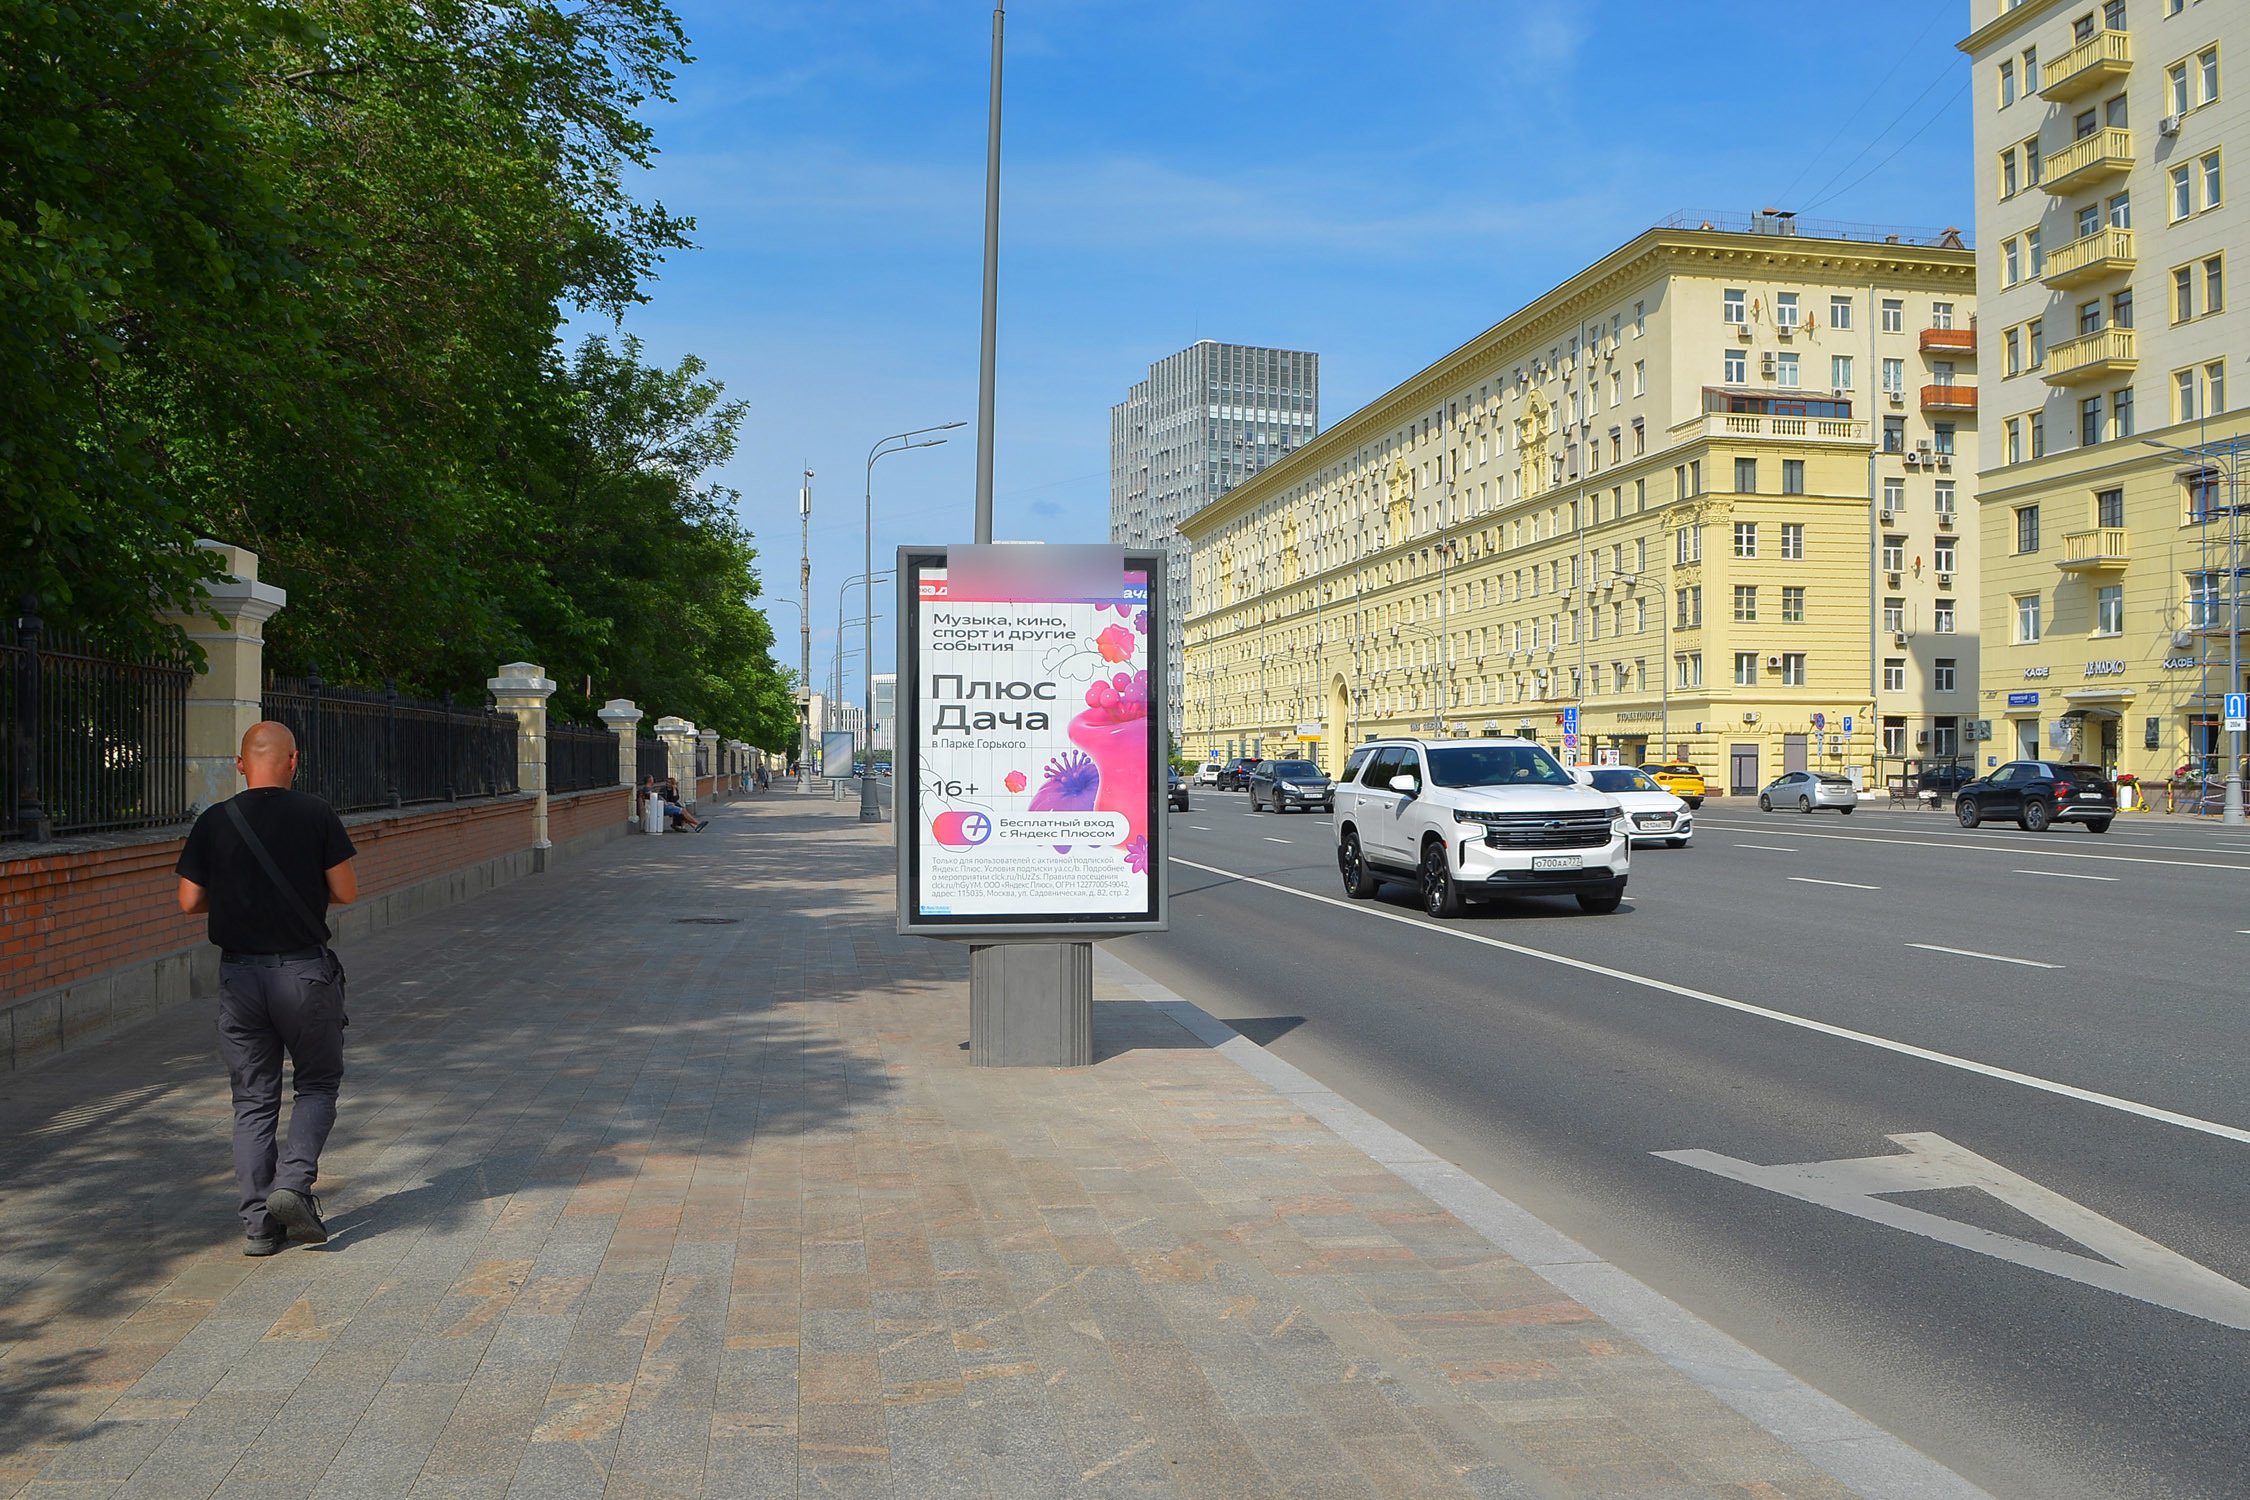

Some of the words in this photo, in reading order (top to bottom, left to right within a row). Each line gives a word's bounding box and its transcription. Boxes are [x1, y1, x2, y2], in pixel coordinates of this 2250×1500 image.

[933, 613, 1012, 627] Музыка,
[1017, 617, 1067, 628] кино,
[933, 629, 989, 640] спорт
[994, 630, 1004, 638] и
[1008, 630, 1076, 641] другие
[933, 640, 1014, 651] события
[2163, 657, 2195, 669] КАФЕ
[2023, 667, 2050, 678] КАФЕ
[932, 674, 1056, 700] Плюс
[932, 705, 1049, 735] Дача
[941, 738, 974, 750] Парке
[977, 738, 1026, 750] Горького
[932, 780, 979, 797] 16+
[1000, 818, 1080, 827] Бесплатный
[1083, 820, 1115, 828] вход
[1010, 829, 1057, 838] Яндекс
[1061, 829, 1115, 838] Плюсом
[932, 865, 958, 873] Яндекс
[1016, 865, 1052, 873] подписки
[1083, 865, 1125, 873] Подробнее
[1043, 873, 1075, 881] Правила
